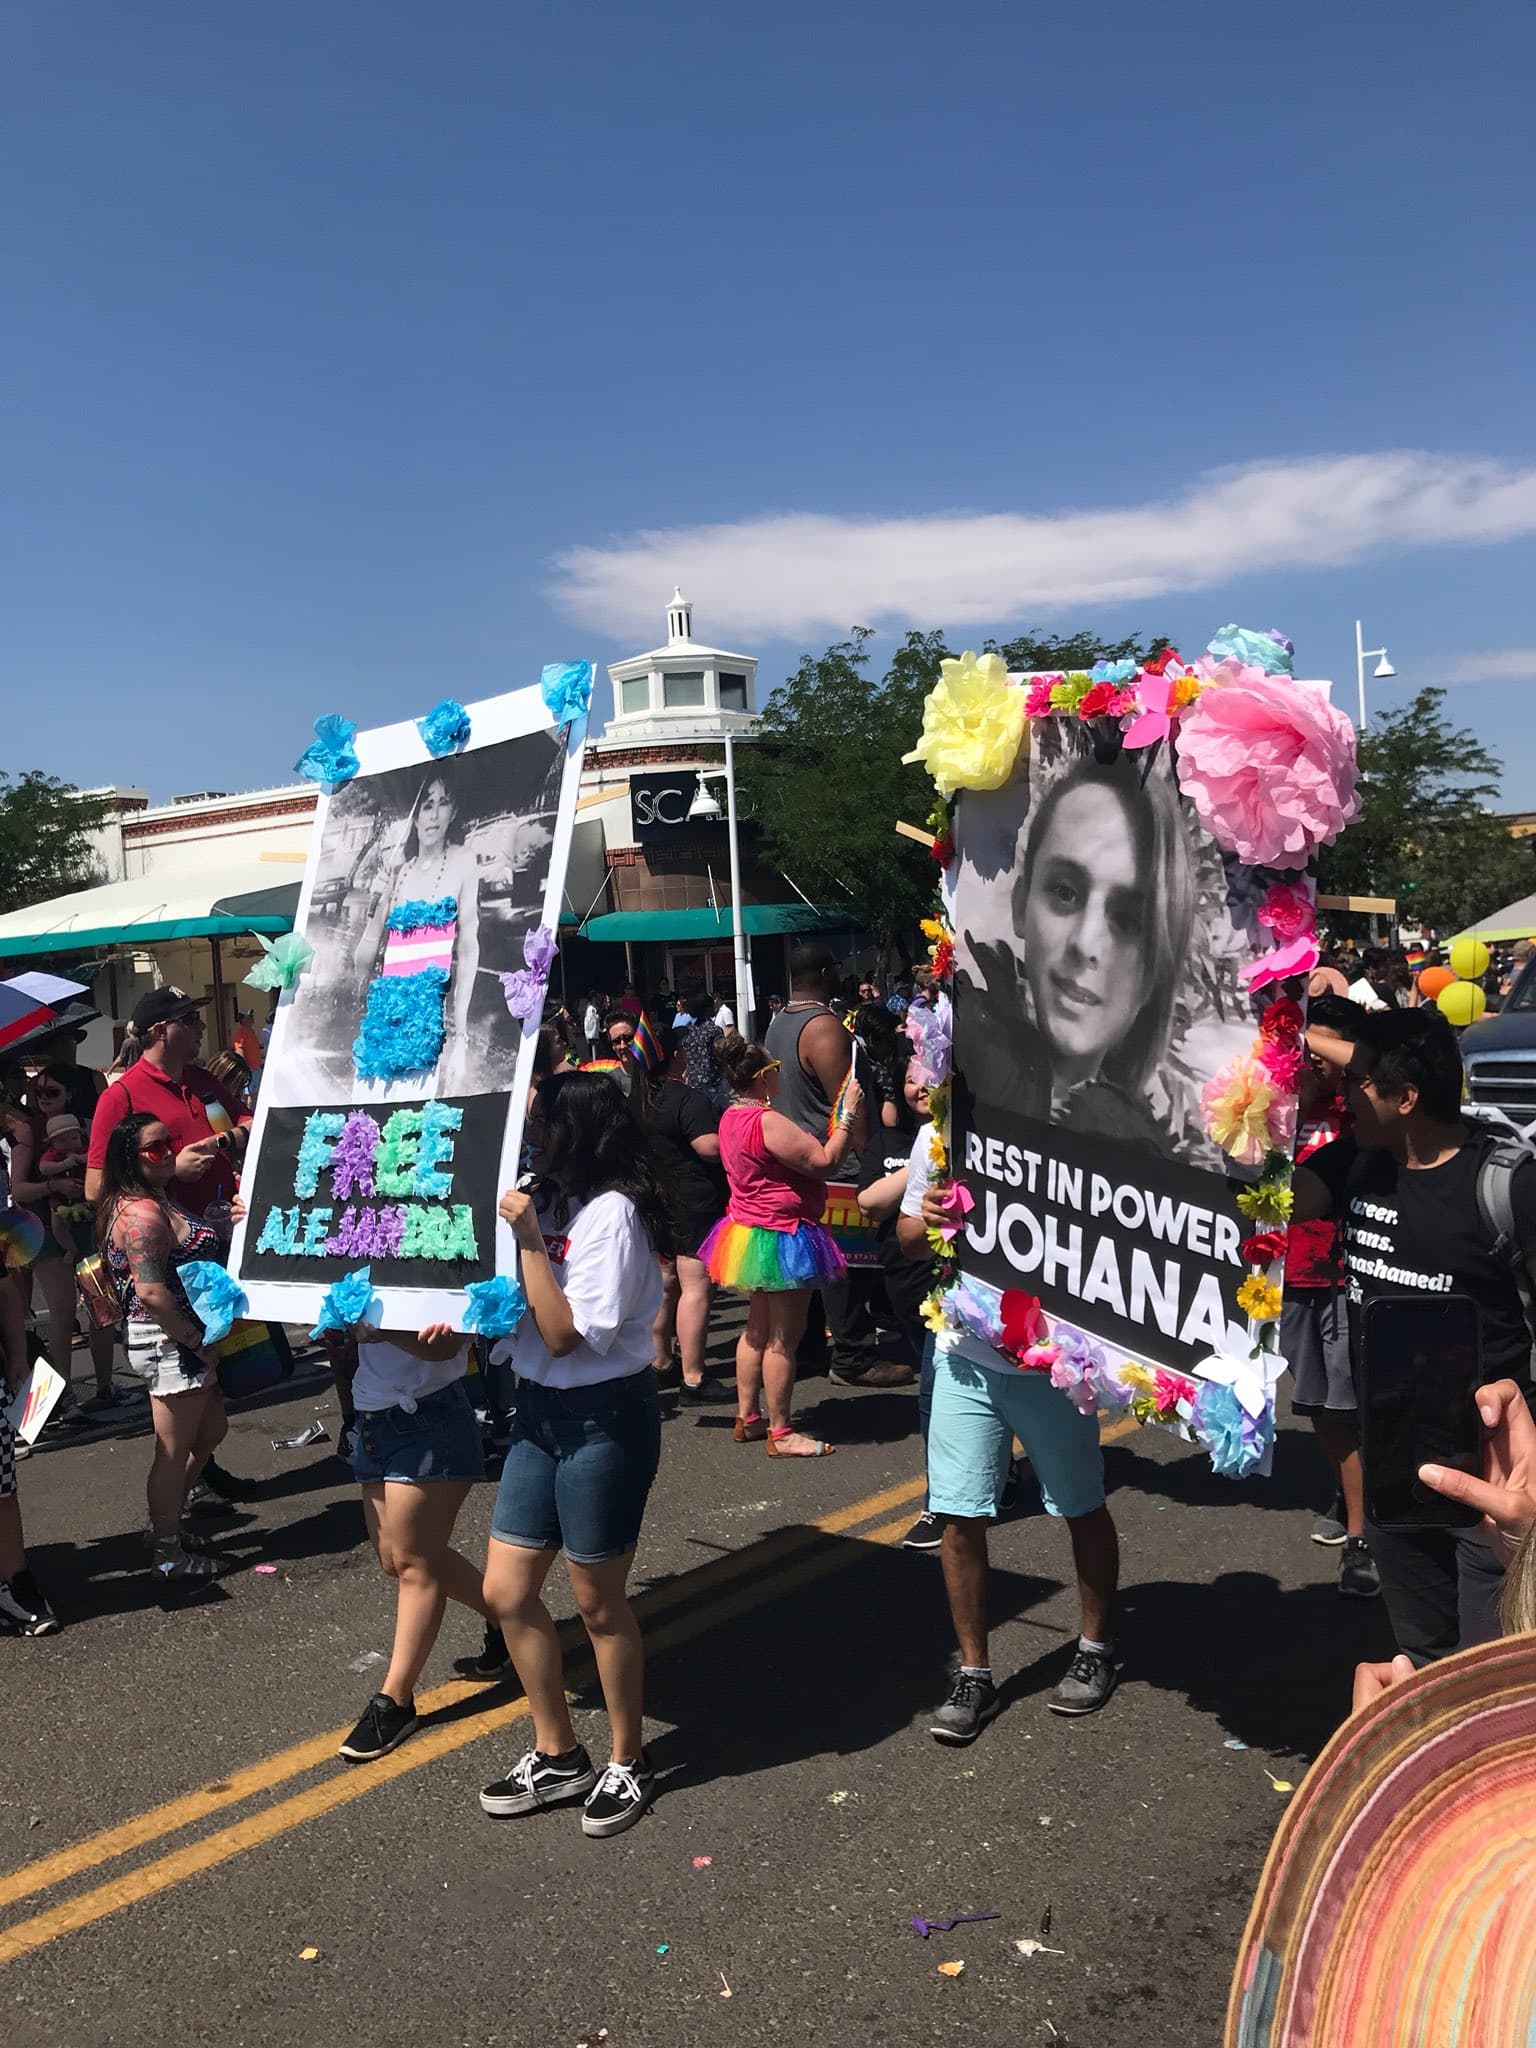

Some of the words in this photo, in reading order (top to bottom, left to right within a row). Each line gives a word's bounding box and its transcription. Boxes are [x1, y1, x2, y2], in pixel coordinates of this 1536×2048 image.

[294, 1099, 464, 1201] FREE
[965, 1131, 1042, 1194] REST
[1047, 1158, 1083, 1211] IN
[1091, 1173, 1243, 1267] POWER
[1350, 1197, 1399, 1226] ueer.
[965, 1190, 1229, 1351] JOHANA
[1345, 1221, 1395, 1253] rans.
[1345, 1249, 1453, 1293] nashamed!
